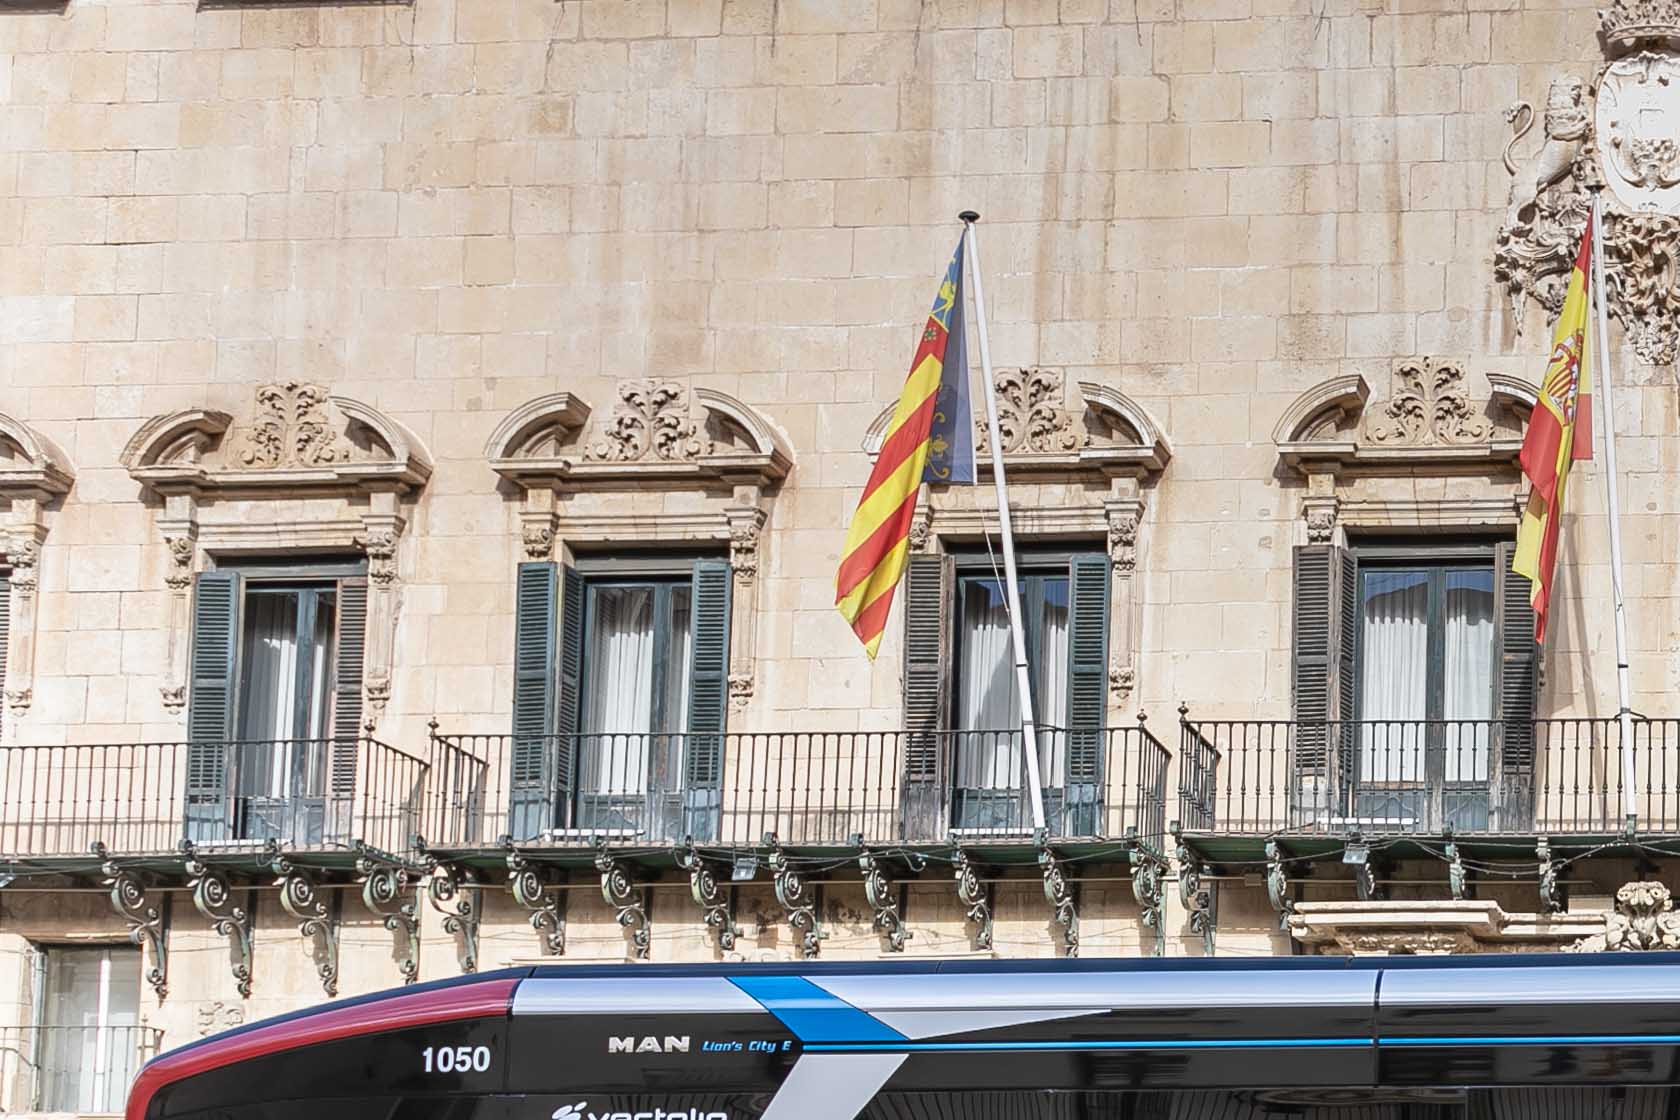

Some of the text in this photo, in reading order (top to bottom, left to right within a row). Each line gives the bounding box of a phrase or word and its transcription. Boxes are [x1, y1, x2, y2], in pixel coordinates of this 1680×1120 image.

[608, 1035, 691, 1053] MAN
[702, 1040, 793, 1053] Lion's City E
[422, 1046, 491, 1073] 1050
